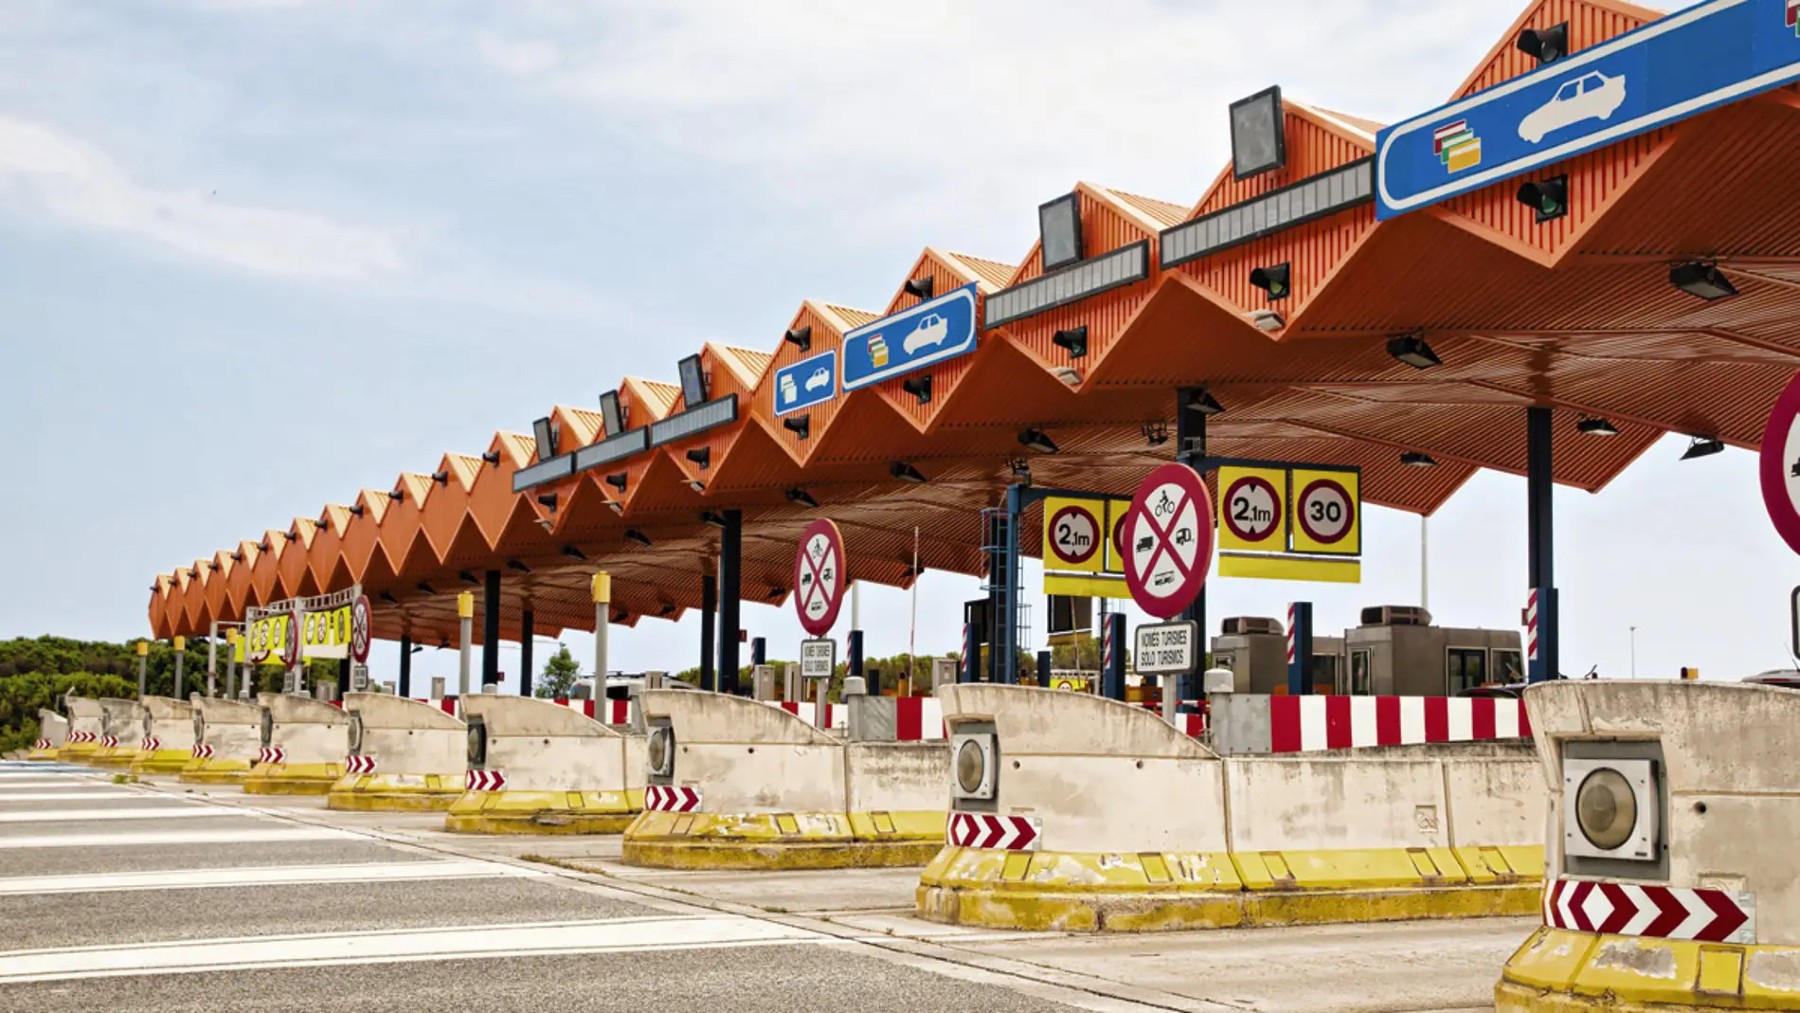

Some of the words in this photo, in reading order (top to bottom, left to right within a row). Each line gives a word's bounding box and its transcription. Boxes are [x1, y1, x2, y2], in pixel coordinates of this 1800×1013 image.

[1233, 496, 1271, 522] 2,1m
[1310, 500, 1341, 522] 30
[1058, 523, 1090, 546] 2,1m
